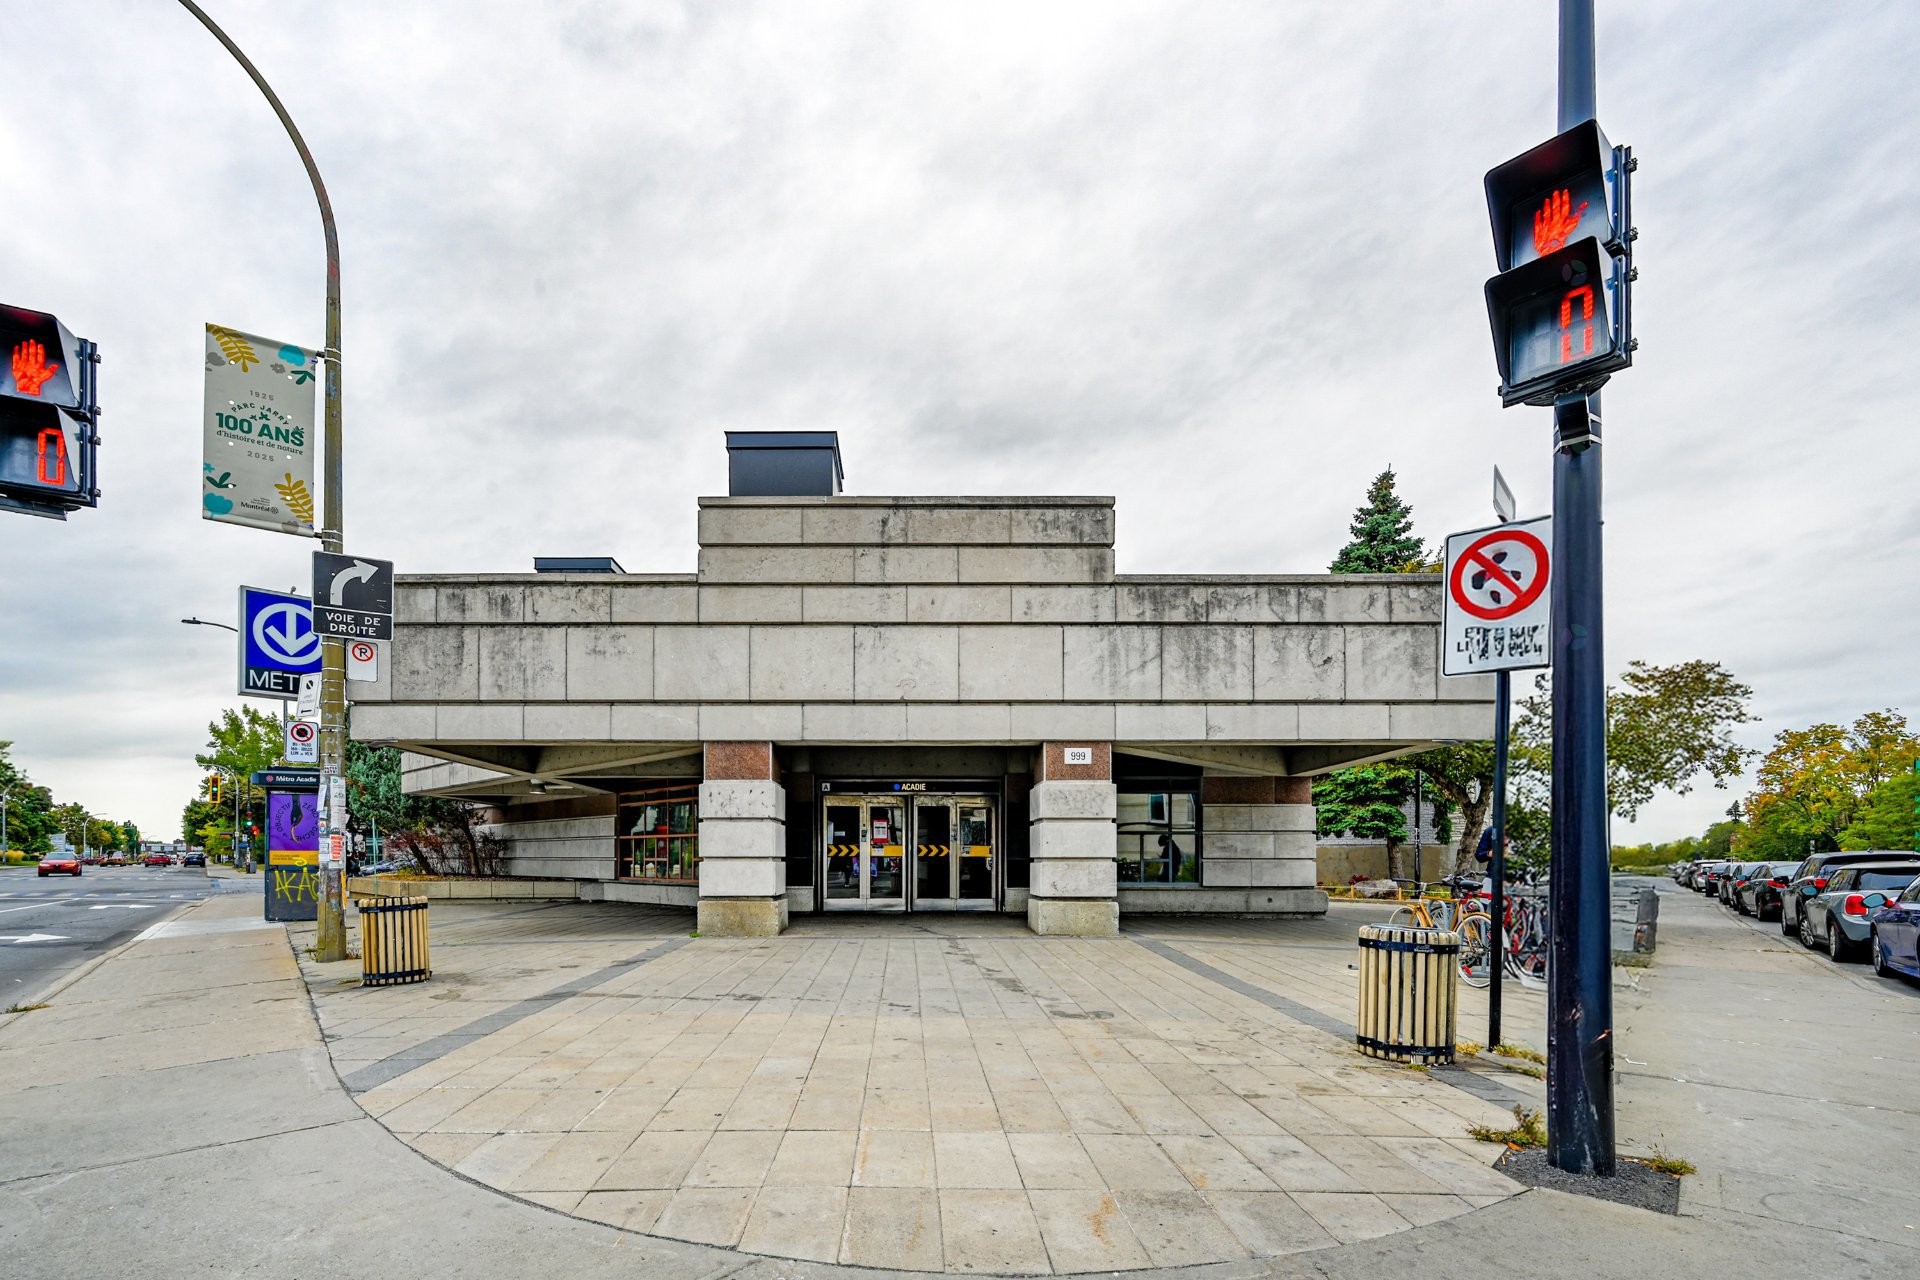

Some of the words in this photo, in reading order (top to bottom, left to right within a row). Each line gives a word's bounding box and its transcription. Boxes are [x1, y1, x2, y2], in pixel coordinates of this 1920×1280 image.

[249, 390, 274, 401] 1925
[231, 402, 255, 413] PARC
[260, 405, 289, 425] JARRY
[215, 412, 253, 434] 100
[257, 423, 304, 447] ANS
[216, 430, 256, 444] d'histoire
[277, 445, 304, 456] nature
[247, 450, 275, 462] 2025
[240, 501, 270, 512] Montréal
[326, 611, 355, 624] VOIE
[364, 616, 381, 626] DE
[330, 623, 377, 636] DROITE
[1070, 752, 1086, 761] 999
[901, 783, 926, 791] ACADIE
